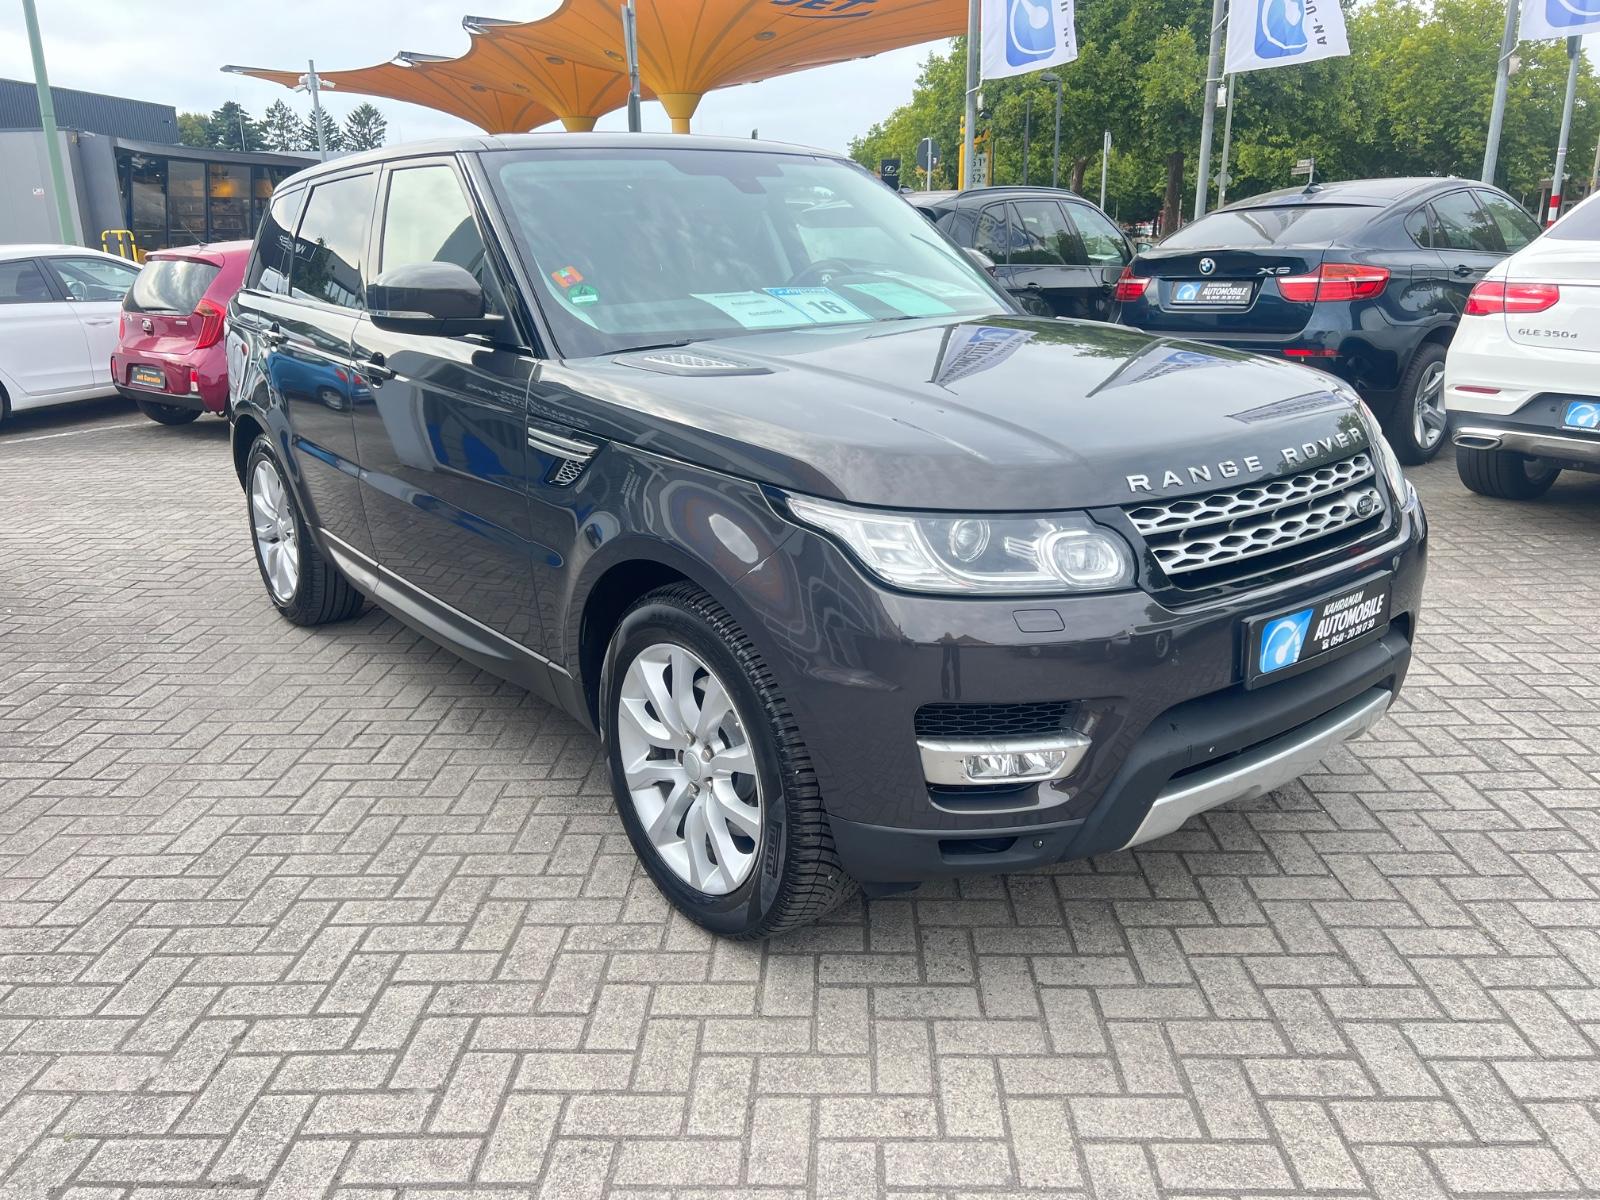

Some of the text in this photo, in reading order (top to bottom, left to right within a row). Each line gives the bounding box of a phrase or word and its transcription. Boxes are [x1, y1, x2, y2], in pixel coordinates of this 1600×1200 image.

[1257, 266, 1291, 275] X6
[1202, 287, 1248, 296] AUTOMOBILE
[1518, 328, 1541, 336] GLE
[1127, 427, 1363, 492] RANGE ROVER
[1323, 591, 1364, 617] KAHRAMAN
[1313, 594, 1385, 641] AUTOMOBILE
